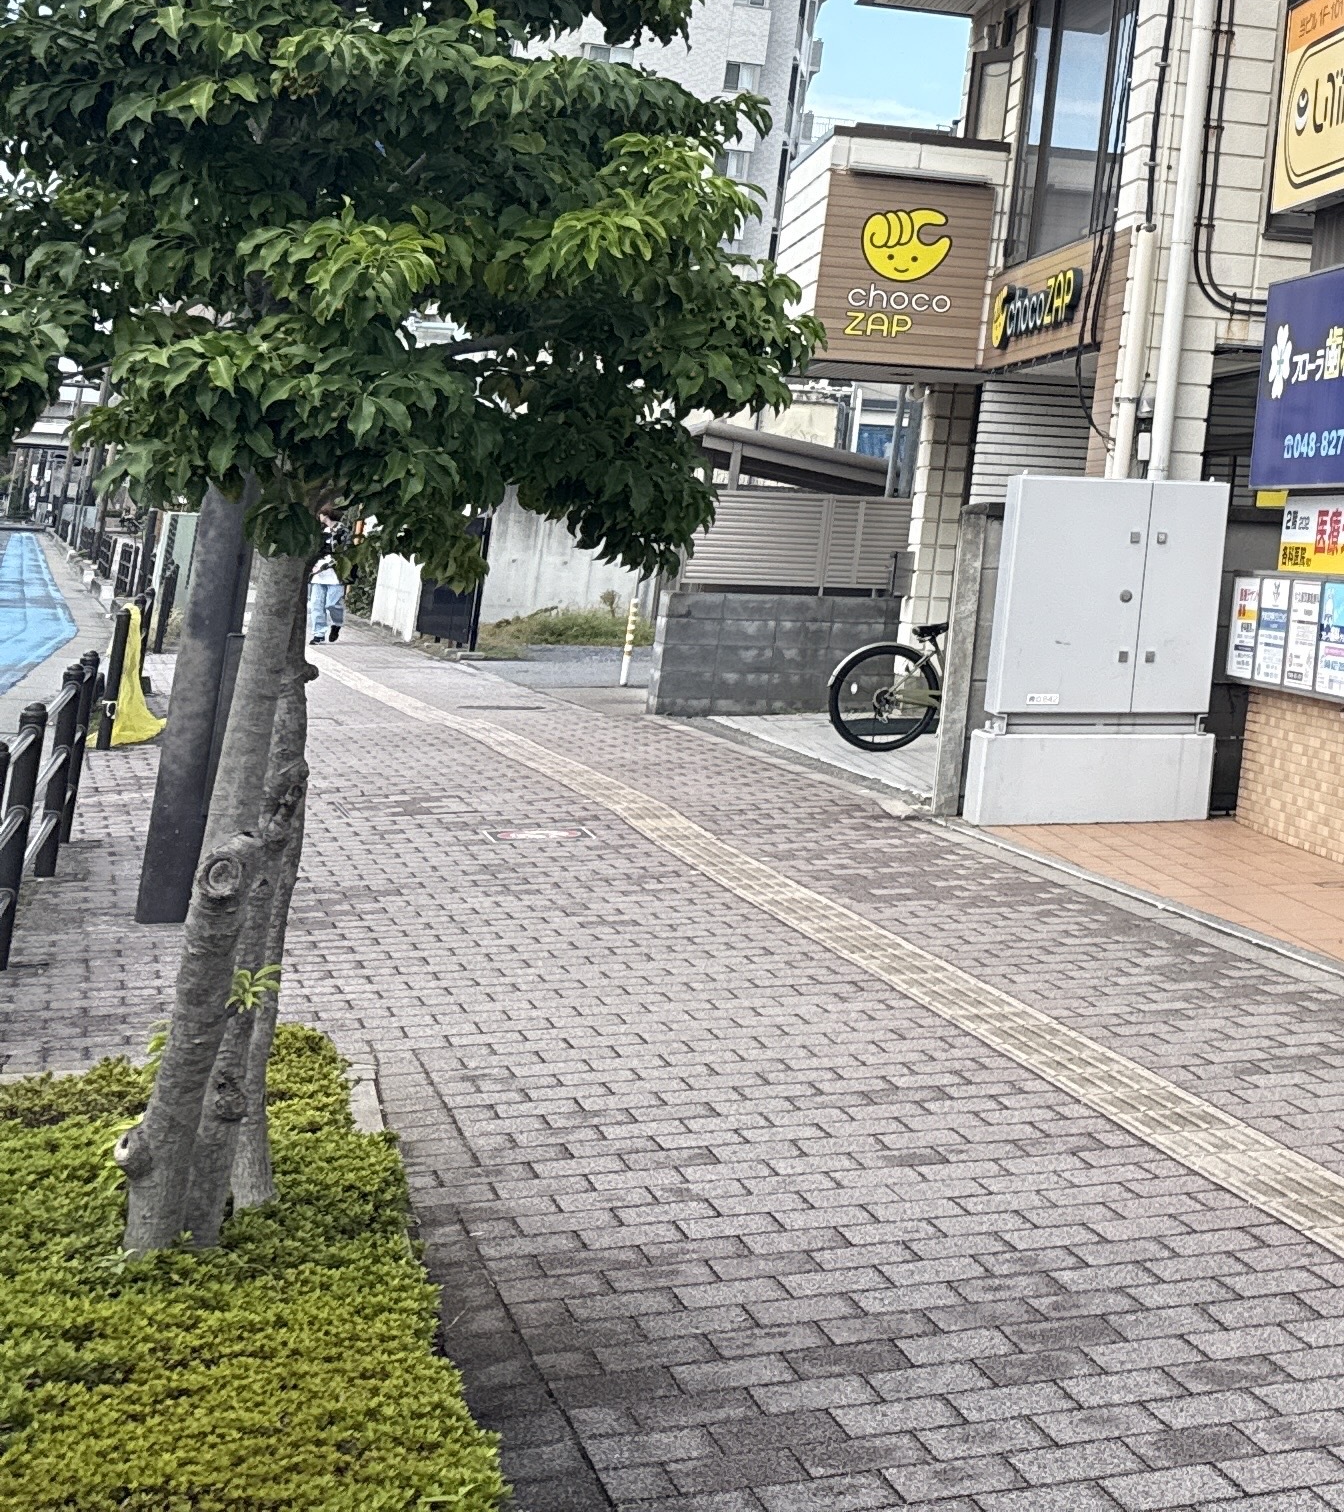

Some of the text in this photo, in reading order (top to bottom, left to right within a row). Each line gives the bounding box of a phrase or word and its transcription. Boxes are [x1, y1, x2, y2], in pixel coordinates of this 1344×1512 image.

[847, 283, 951, 313] choco
[1006, 268, 1076, 336] chocoZAP
[843, 311, 913, 338] ZAP
